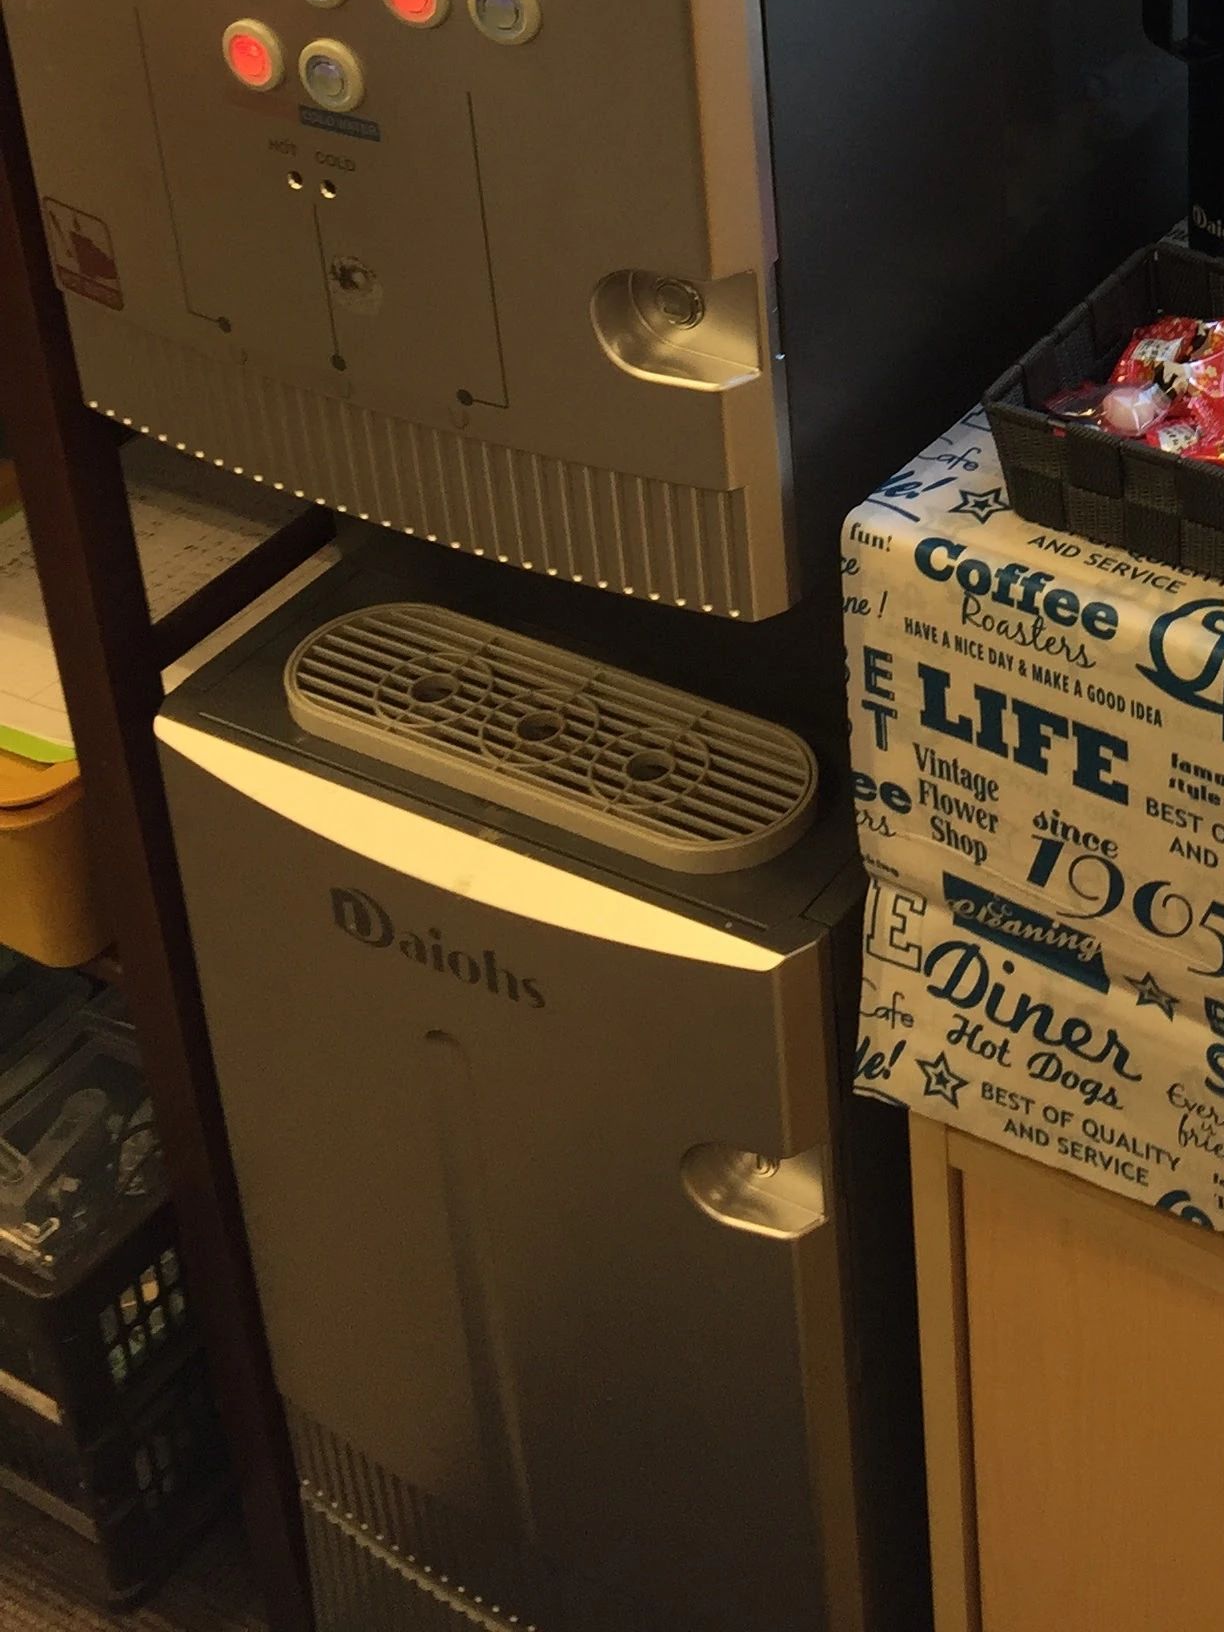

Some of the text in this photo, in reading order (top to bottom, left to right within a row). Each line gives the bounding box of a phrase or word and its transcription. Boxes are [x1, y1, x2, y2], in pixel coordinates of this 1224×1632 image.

[914, 536, 1118, 644] Coffee
[1028, 536, 1081, 557] AND
[1084, 554, 1186, 594] SERVICE
[961, 590, 1097, 669] Roasters
[904, 617, 1162, 727] HAVE NICE DAY MAKE GOOD IDEA
[912, 659, 1129, 806] LIFE
[912, 742, 999, 802] Vintage
[919, 774, 999, 834] Flower
[930, 815, 987, 866] Shop
[1033, 809, 1118, 859] since
[1146, 797, 1203, 833] BEST
[1169, 837, 1218, 868] AND
[330, 887, 546, 1009] Daiohs
[924, 940, 1143, 1083] Diner
[947, 1013, 1125, 1112] Hot Dogs
[981, 1082, 1180, 1175] BEST OF QUALITY
[1003, 1118, 1148, 1187] AND SERVICE
